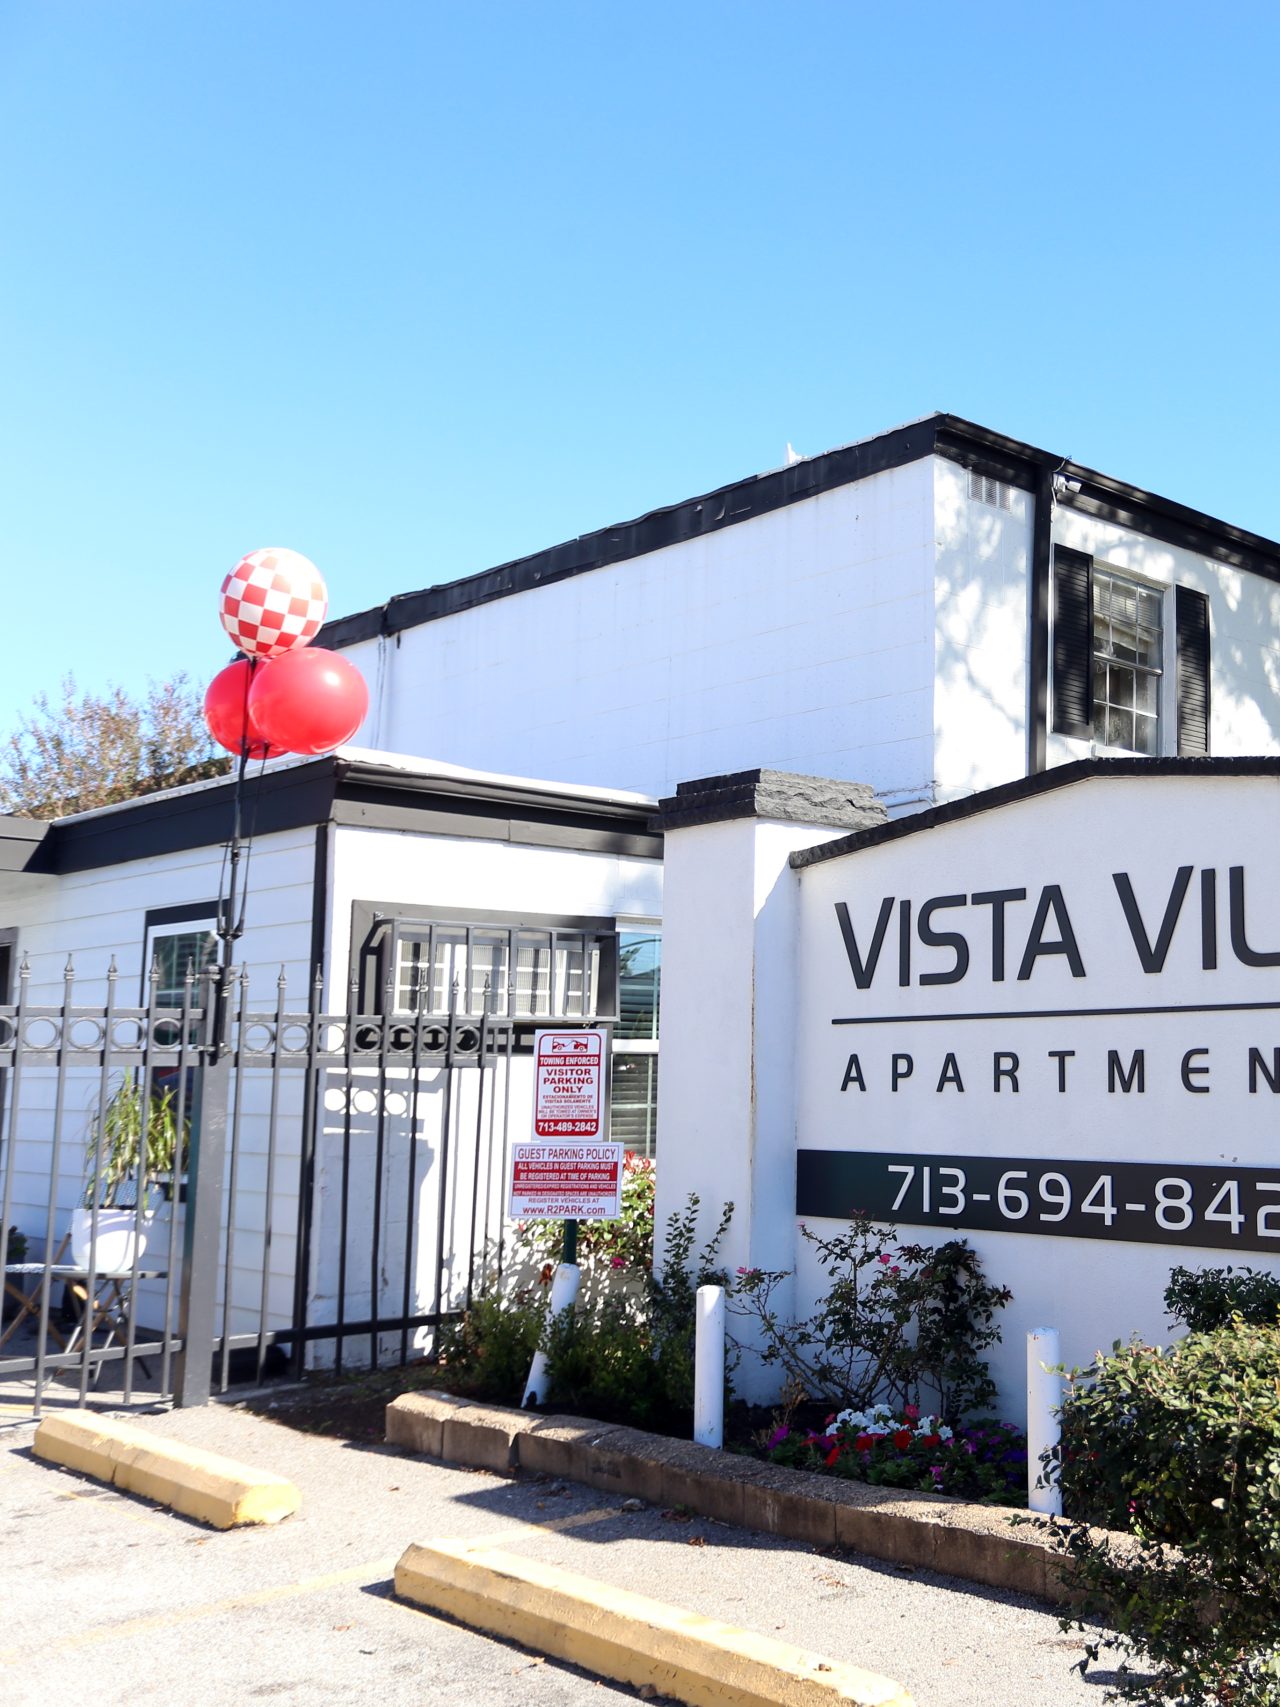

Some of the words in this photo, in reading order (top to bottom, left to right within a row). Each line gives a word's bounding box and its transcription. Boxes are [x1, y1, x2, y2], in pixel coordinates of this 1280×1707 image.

[835, 885, 1086, 989] VISTA
[540, 1056, 564, 1066] TOWING
[566, 1056, 598, 1065] ENFORCED
[553, 1086, 583, 1094] ONLY
[538, 1122, 596, 1132] 713-489-2842
[518, 1148, 546, 1159] GUEST
[548, 1148, 584, 1159] PARKING
[586, 1148, 616, 1160] POLICY
[523, 1205, 605, 1214] www.R2PARK.com
